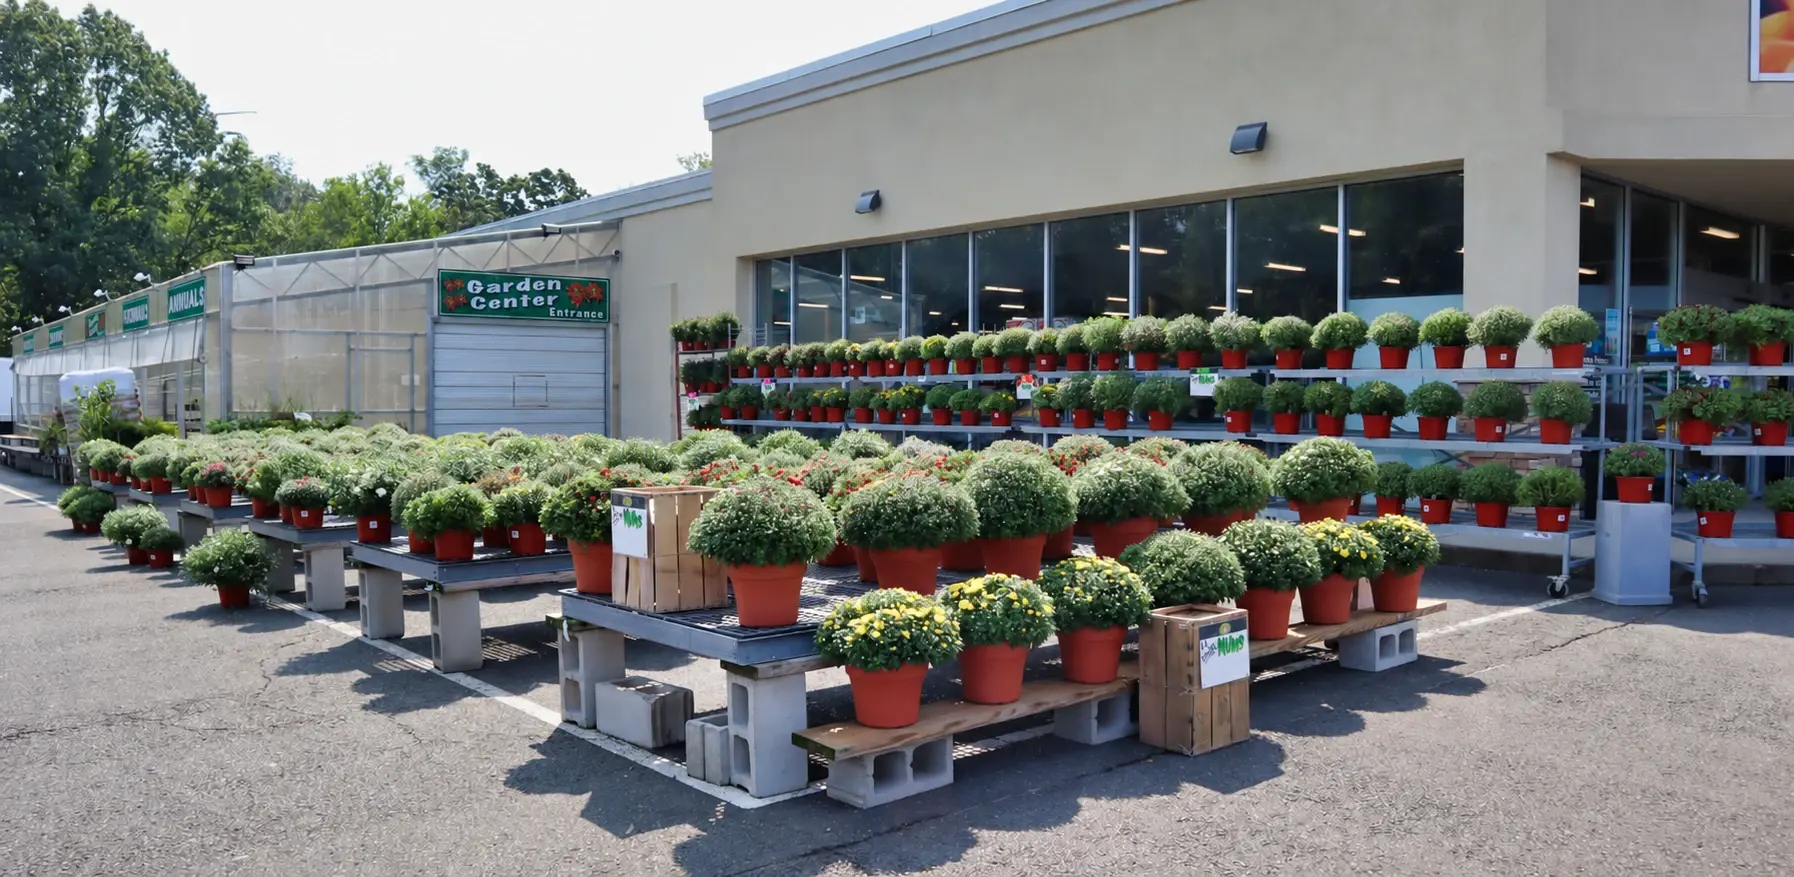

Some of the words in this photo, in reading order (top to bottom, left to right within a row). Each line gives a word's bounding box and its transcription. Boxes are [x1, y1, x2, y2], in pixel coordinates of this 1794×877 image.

[466, 278, 561, 294] Garden
[168, 286, 205, 314] ANNUALS
[470, 294, 559, 310] Center
[549, 307, 604, 319] Entrance
